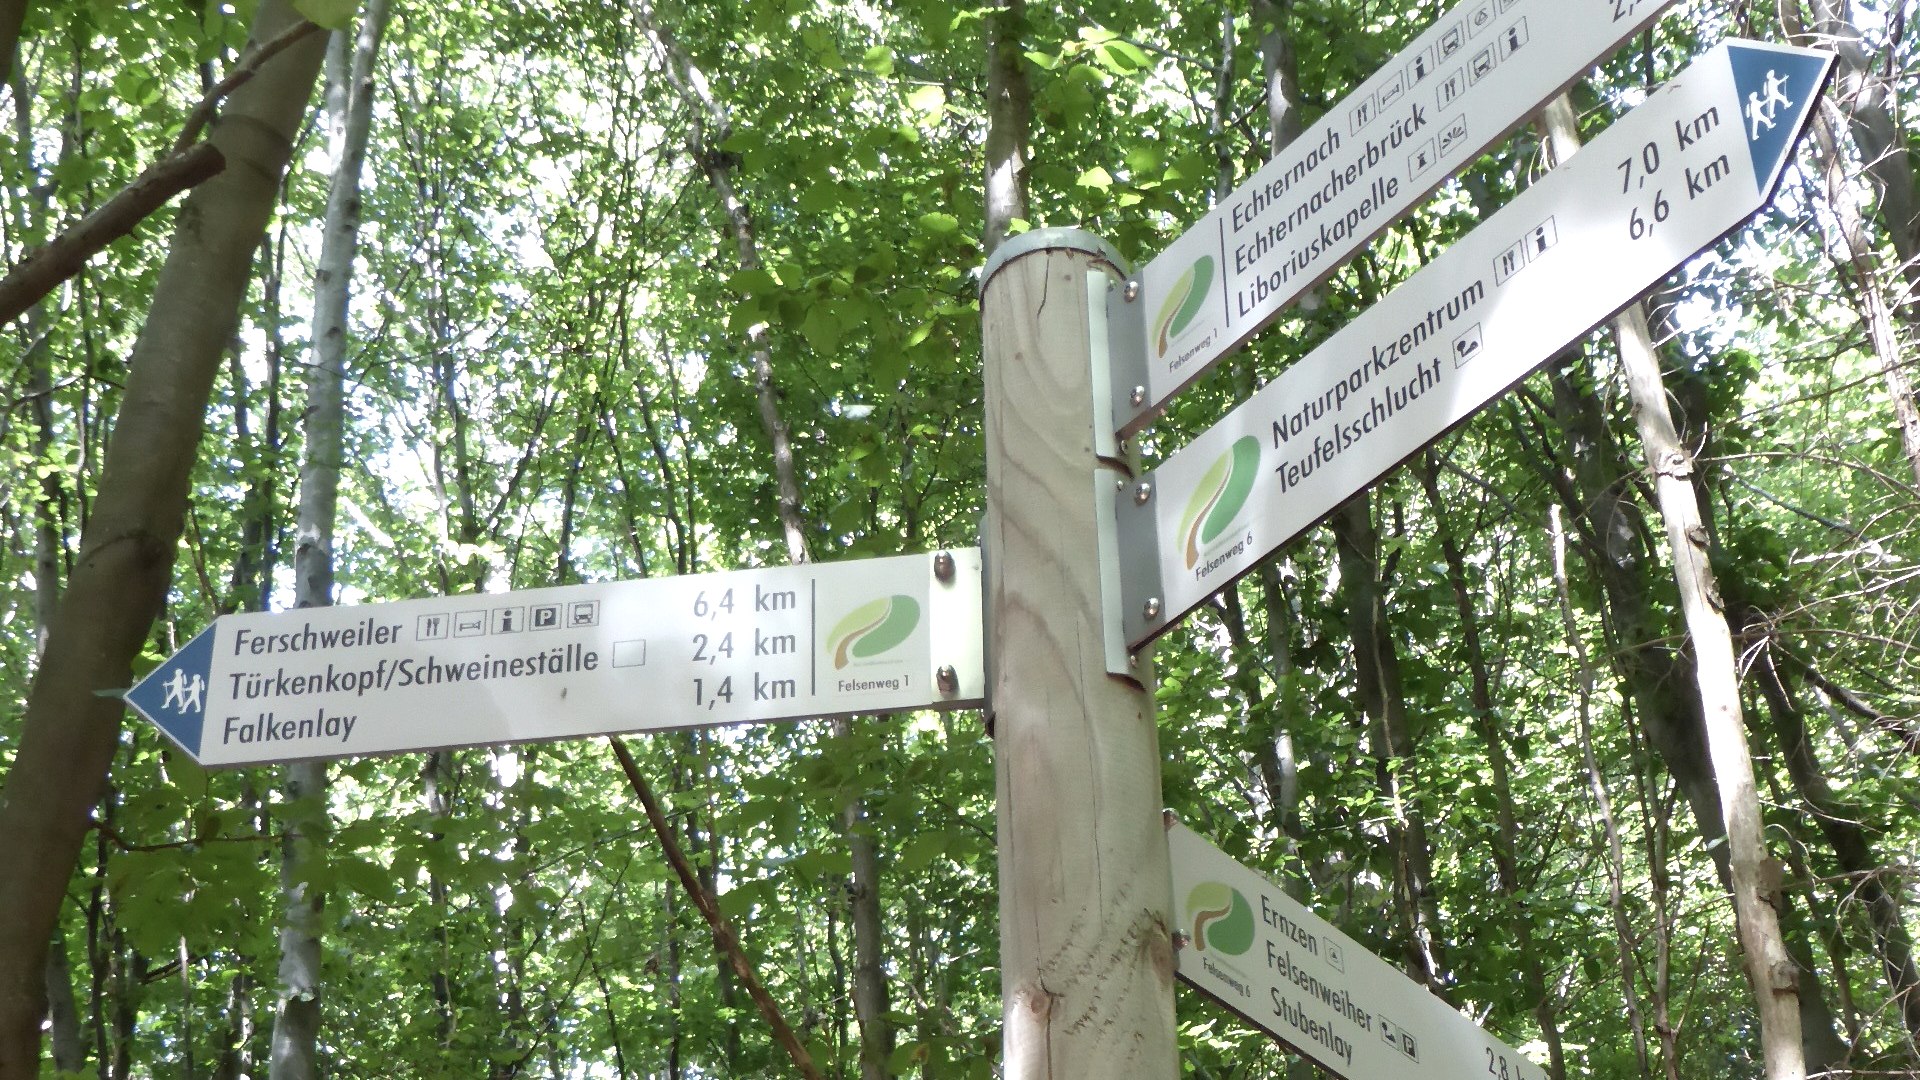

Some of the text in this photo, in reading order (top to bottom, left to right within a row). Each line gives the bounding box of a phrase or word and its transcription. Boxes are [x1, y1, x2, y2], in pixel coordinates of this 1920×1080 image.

[1232, 127, 1341, 233] Echternach
[1235, 103, 1427, 275] Echternacherbrück
[1239, 175, 1399, 318] Liboriuskapelle
[1273, 106, 1720, 449] Naturparkzentrum 7,0 km
[1169, 335, 1210, 373] Felsenweg
[1275, 154, 1731, 494] Teufelsschlucht 6,6 km
[1195, 540, 1244, 581] Felsenweg
[1246, 530, 1253, 546] 6
[234, 584, 797, 656] Ferschweiler 6,4 km
[229, 628, 796, 701] Türkenkopf/Schweineställe 2,4 km
[838, 678, 899, 692] Felsenweg
[223, 672, 796, 744] Falkenlay 1,4 km
[1260, 894, 1318, 956] Ernzen
[1203, 956, 1244, 996] Felsenweg
[1266, 940, 1372, 1032] Felsenweiher
[1270, 986, 1352, 1066] Stubenlay
